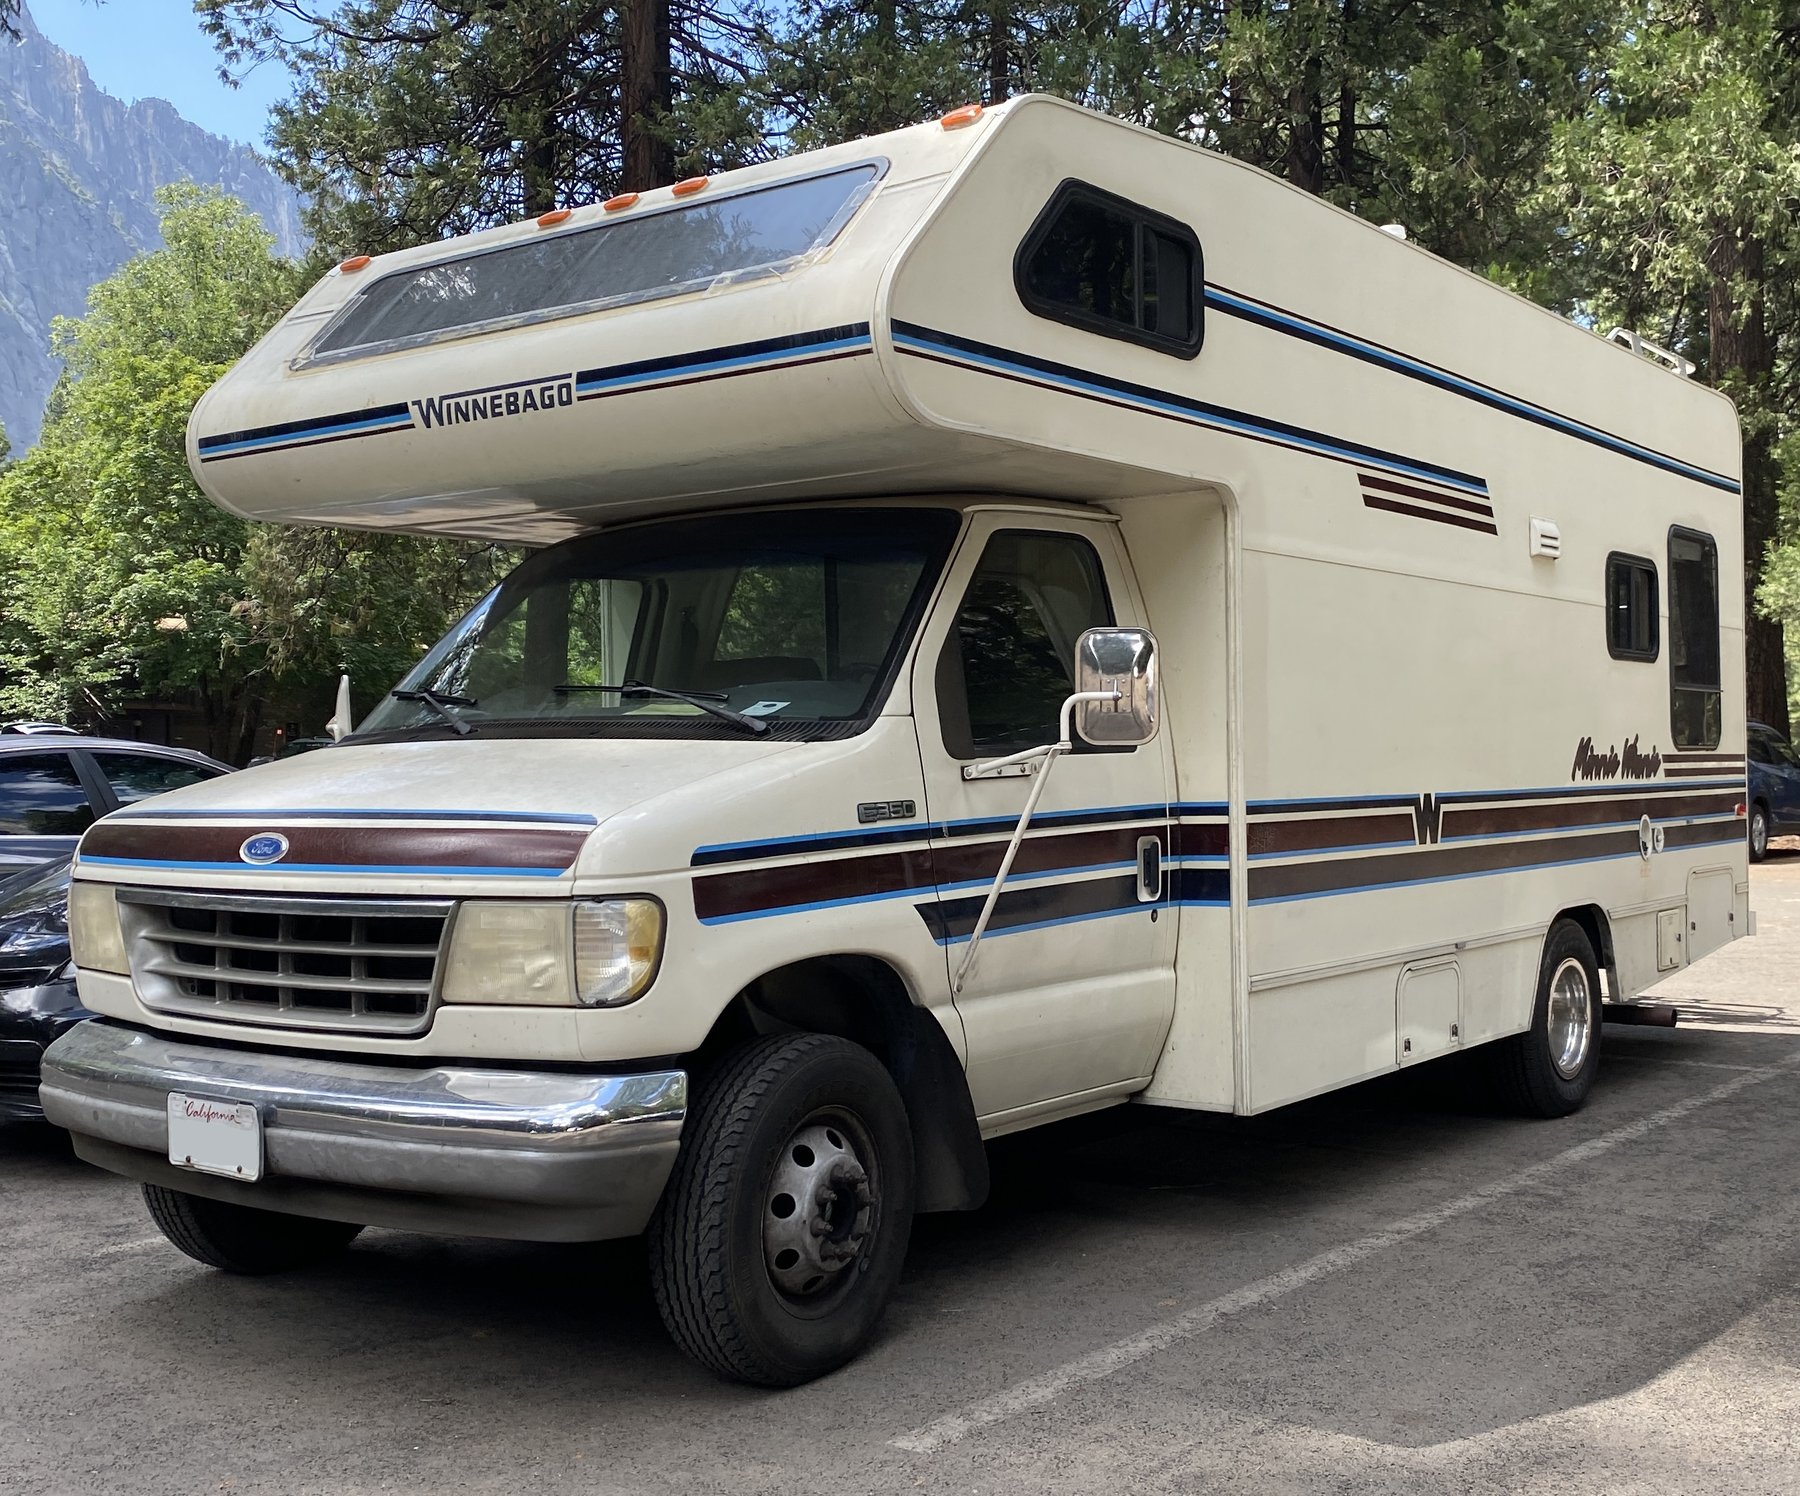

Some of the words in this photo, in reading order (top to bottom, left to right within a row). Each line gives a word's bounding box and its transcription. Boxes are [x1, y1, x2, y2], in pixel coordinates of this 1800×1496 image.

[411, 374, 573, 429] WINNEBAGO
[1571, 736, 1620, 782] Minnie
[857, 800, 916, 822] E350
[1414, 793, 1441, 846] W
[251, 840, 277, 855] Ford
[185, 1101, 241, 1123] California
